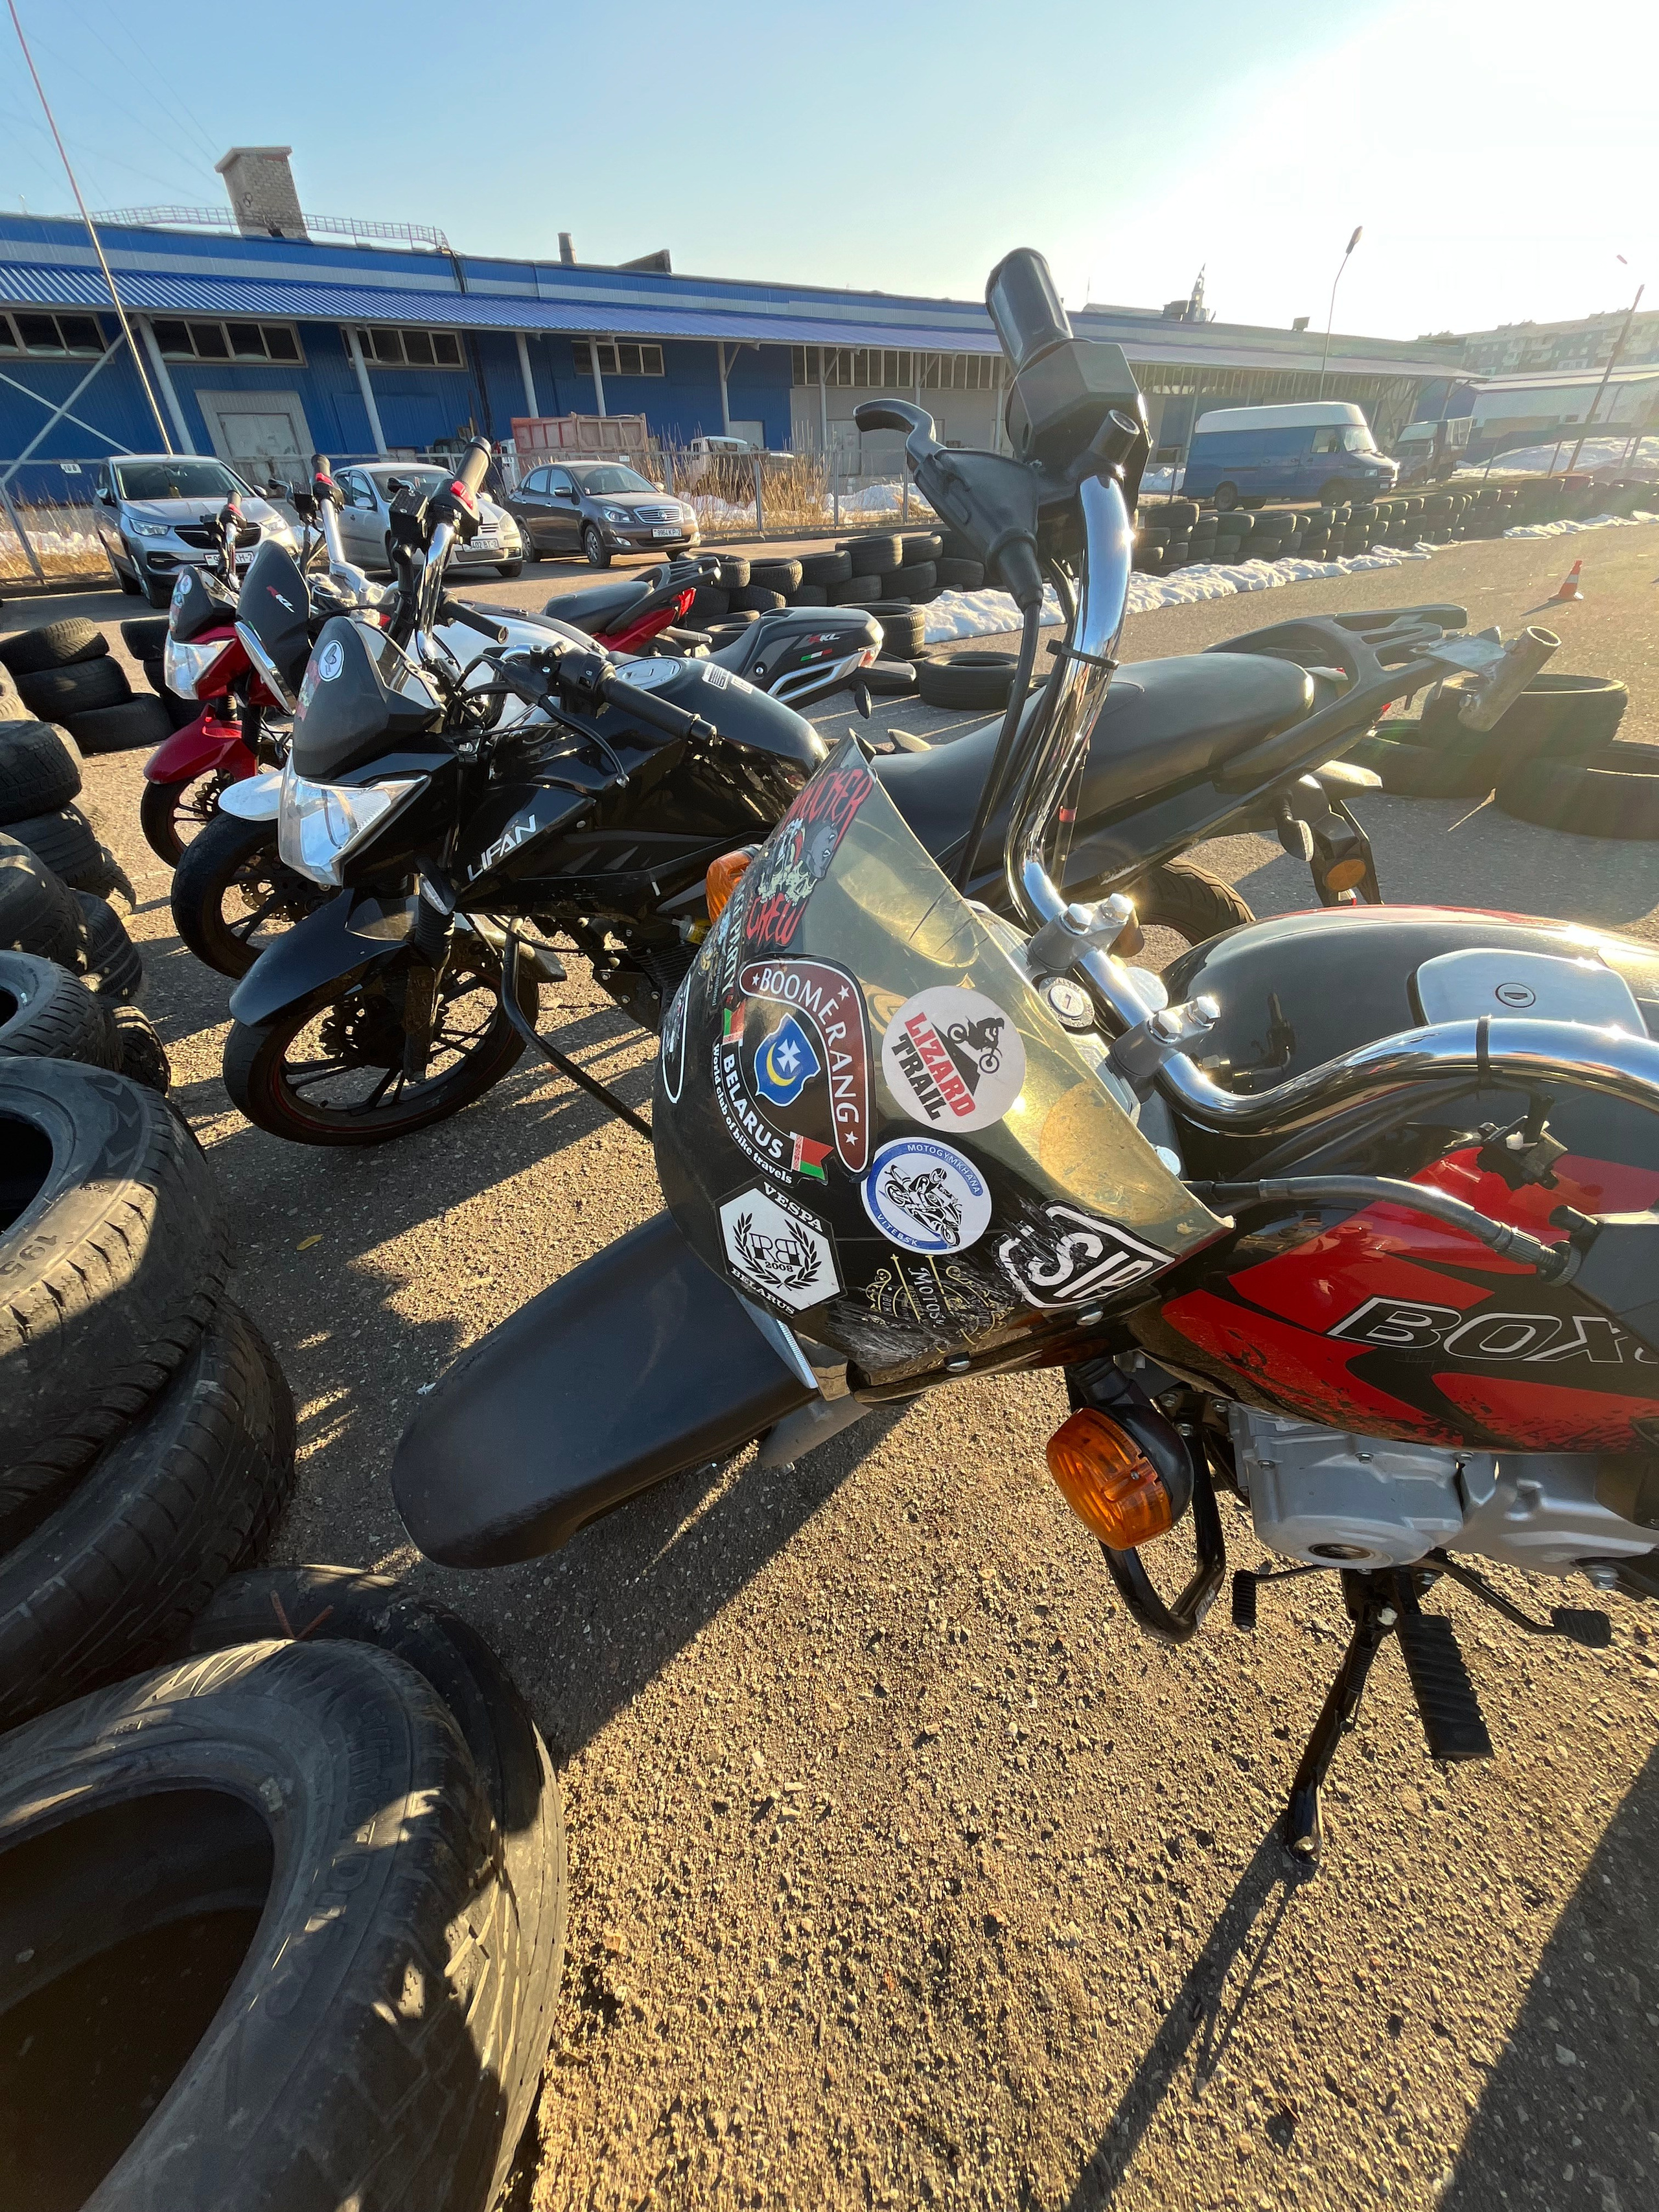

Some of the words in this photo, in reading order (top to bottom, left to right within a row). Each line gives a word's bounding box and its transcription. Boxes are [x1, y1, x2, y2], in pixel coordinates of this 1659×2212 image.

[470, 540, 482, 549] 402
[467, 814, 537, 881] LIFAN
[747, 892, 807, 947] CREW
[722, 916, 743, 995] PARTY
[713, 1043, 721, 1085] World
[758, 968, 860, 1124] BOOMERANG
[904, 1012, 976, 1117] LIZARD
[716, 1086, 728, 1115] club
[891, 1032, 947, 1121] TRAIL
[723, 1053, 784, 1159] BELARUS
[726, 1116, 736, 1130] of
[732, 1127, 752, 1156] bike
[753, 1152, 793, 1184] travels
[907, 1144, 980, 1194] MOTOGYMKHANA
[763, 1182, 823, 1232] VESPA
[877, 1214, 919, 1246] VITEBSK
[731, 1267, 796, 1315] BELARUS
[765, 1261, 794, 1272] 2008
[1326, 1297, 1658, 1364] BOX
